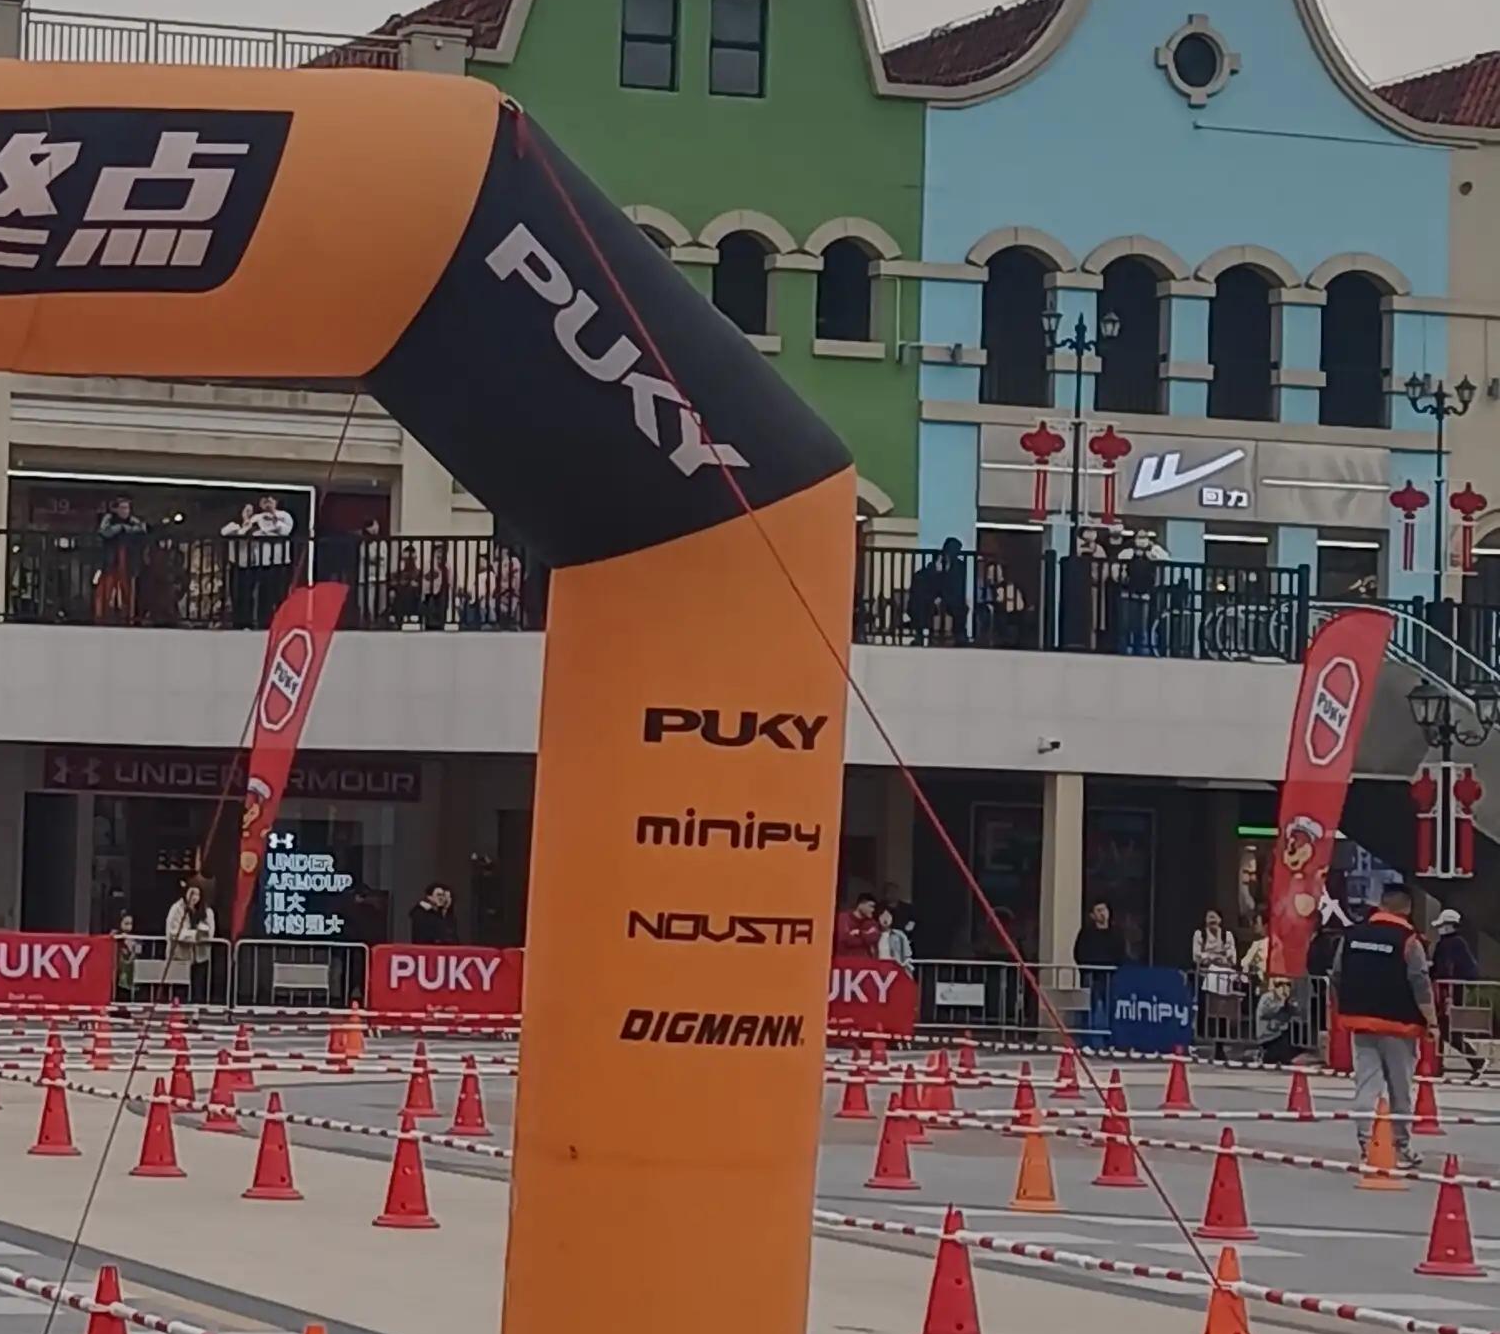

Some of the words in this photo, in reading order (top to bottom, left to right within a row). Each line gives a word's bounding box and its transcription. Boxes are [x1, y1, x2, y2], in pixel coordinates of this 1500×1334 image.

[485, 223, 750, 477] PUKY
[1202, 487, 1248, 507] 回力
[643, 707, 828, 750] PUKY
[636, 807, 821, 851] minipy
[390, 954, 501, 991] PUKY
[1114, 993, 1189, 1027] minipy
